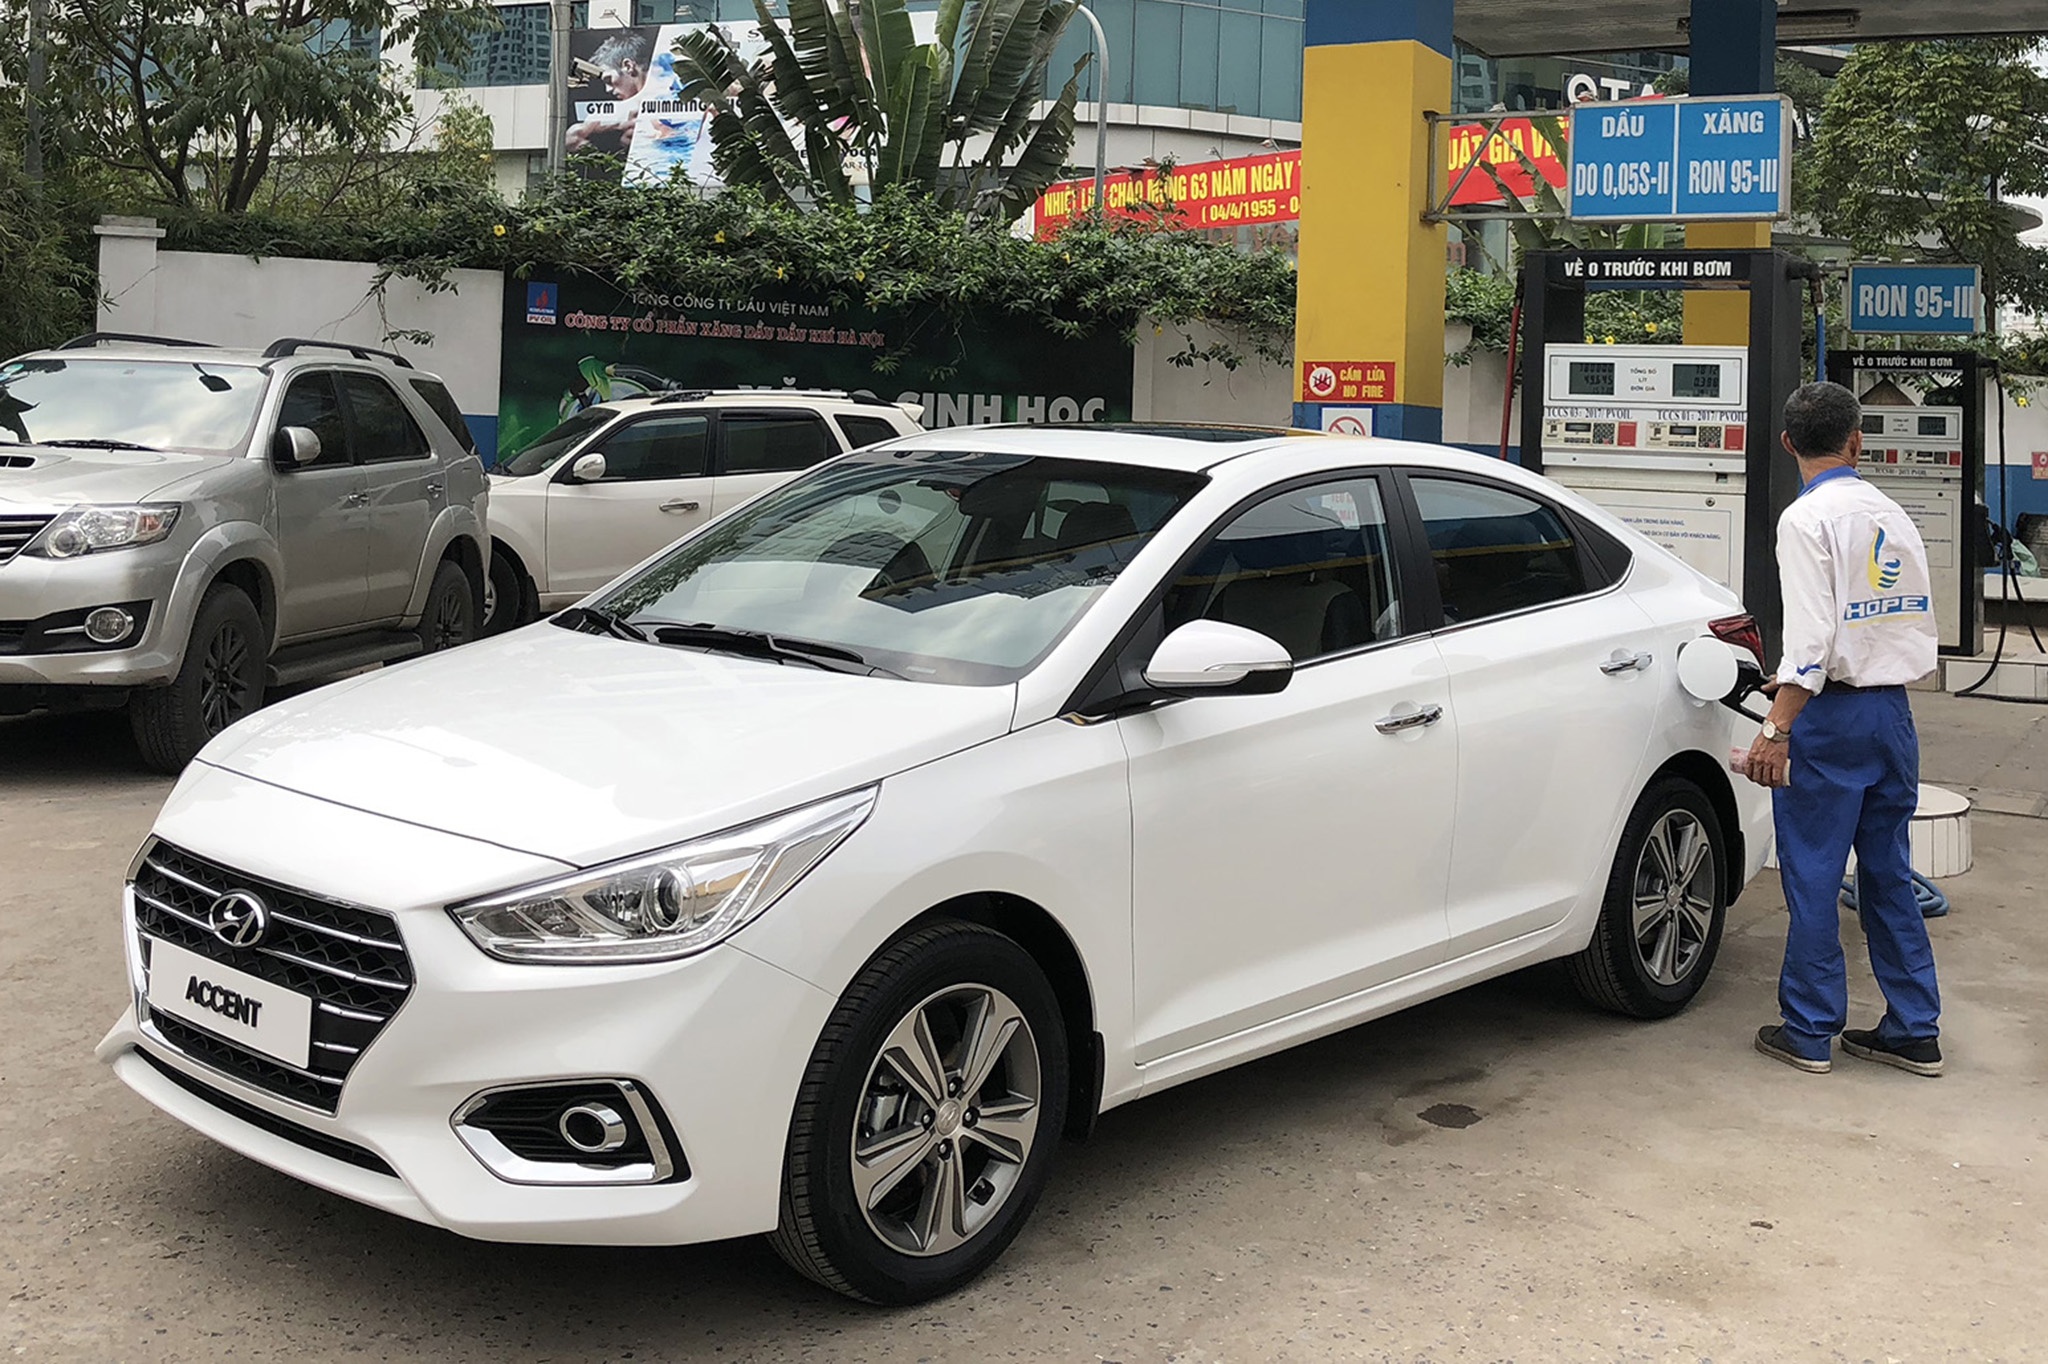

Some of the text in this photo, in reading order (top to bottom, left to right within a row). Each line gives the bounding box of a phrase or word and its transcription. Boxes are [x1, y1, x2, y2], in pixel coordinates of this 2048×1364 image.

[586, 102, 615, 115] GYM
[1601, 108, 1645, 138] DẦU
[1703, 107, 1764, 135] XĂNG
[1190, 172, 1208, 200] 63
[1211, 163, 1247, 197] NĂM
[1251, 156, 1295, 193] NGÀY
[1575, 162, 1598, 196] DO
[1688, 159, 1777, 194] RON 95-III
[1564, 256, 1584, 276] VỀ
[1603, 256, 1656, 277] TRƯỚC
[1660, 261, 1689, 277] KHI
[1693, 260, 1732, 277] BƠM
[769, 300, 797, 317] VIỆT
[800, 305, 829, 317] NAM
[1859, 284, 1975, 318] RON 95-III
[564, 310, 609, 330] CÔNG
[610, 316, 631, 331] TY
[700, 320, 742, 338] XĂNG
[808, 326, 836, 344] KHÍ
[837, 328, 858, 345] HÀ
[1852, 354, 1865, 366] VỀ
[1910, 357, 1927, 367] KHI
[1343, 385, 1385, 398] NO FIRE
[1845, 596, 1924, 619] HOPE
[185, 975, 262, 1028] ACCENT
